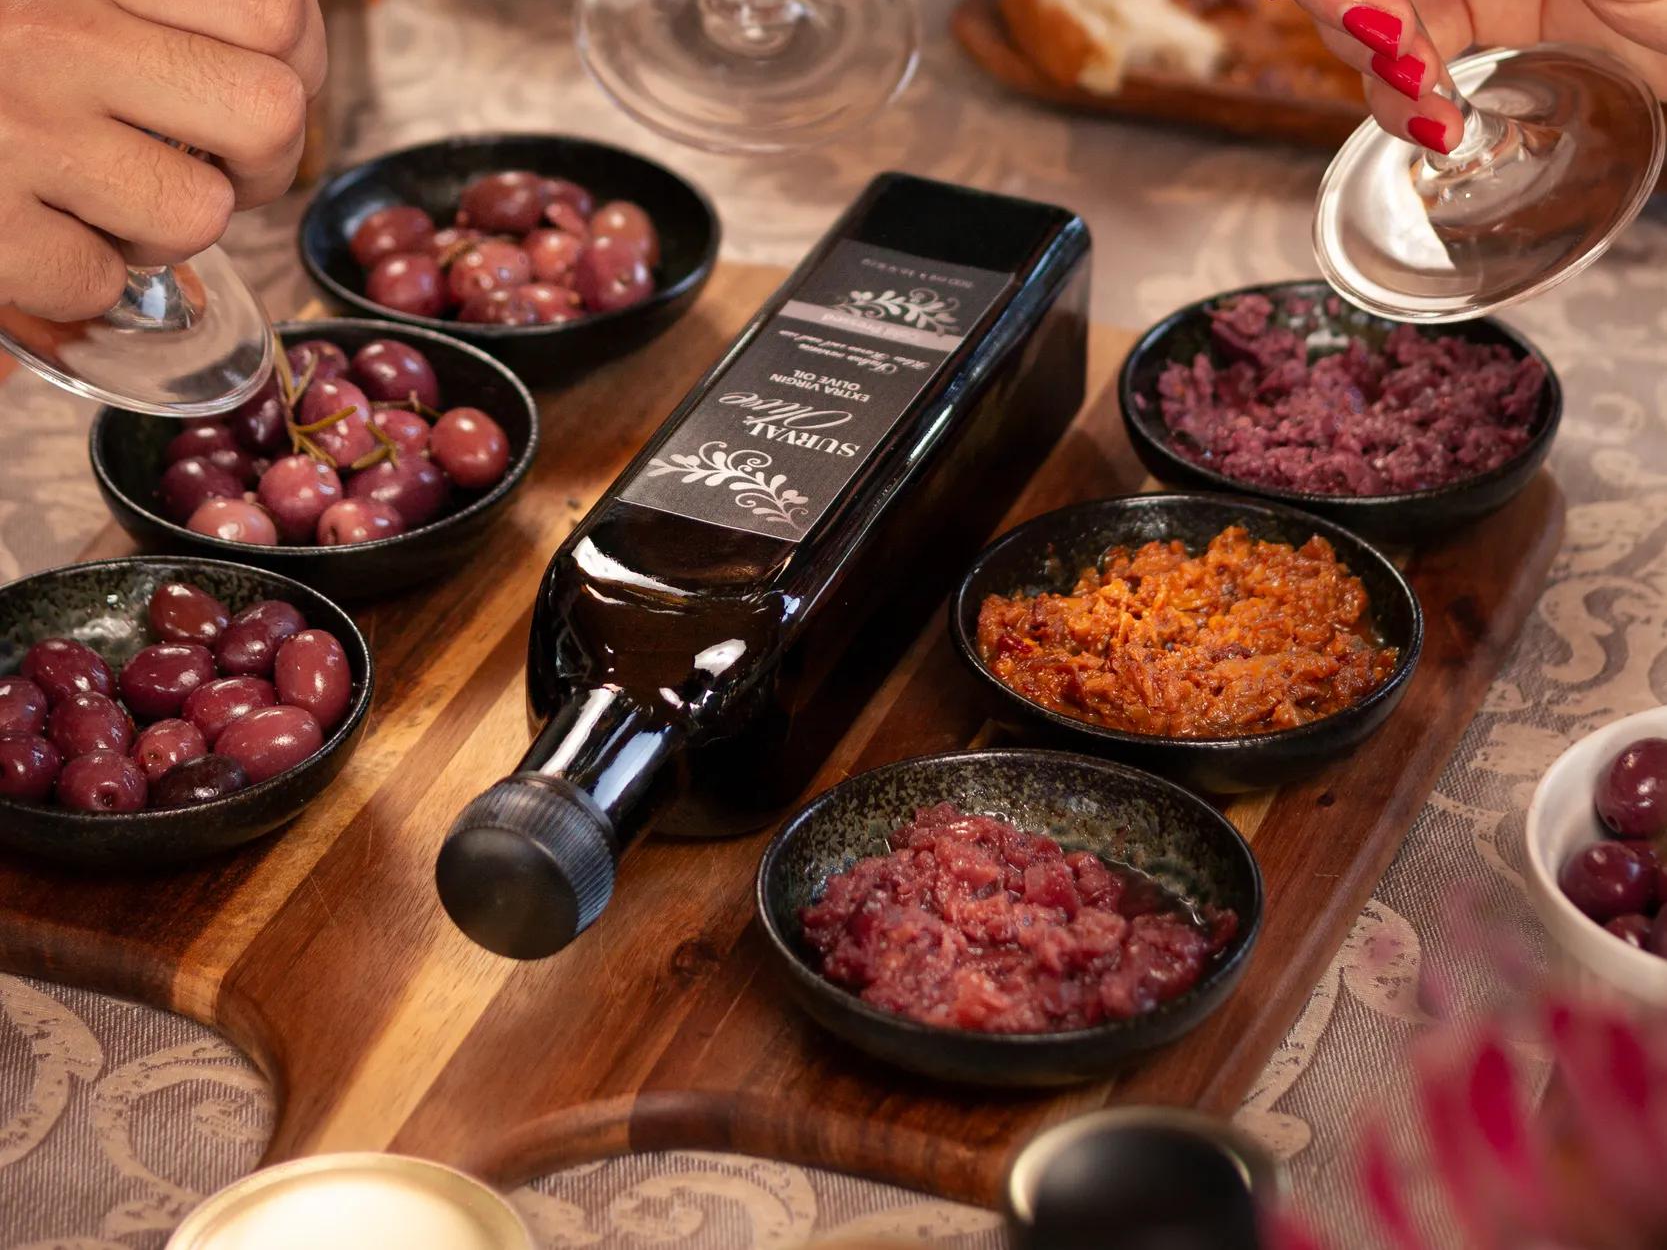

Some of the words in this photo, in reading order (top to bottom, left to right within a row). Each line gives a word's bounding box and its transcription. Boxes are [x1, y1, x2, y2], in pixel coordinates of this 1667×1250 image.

[769, 373, 821, 392] VIRGIN
[793, 369, 817, 381] OIL
[819, 375, 861, 392] OLIVE
[824, 386, 873, 403] EXTRA
[718, 392, 853, 430] Olive
[749, 422, 861, 458] SURVAL
